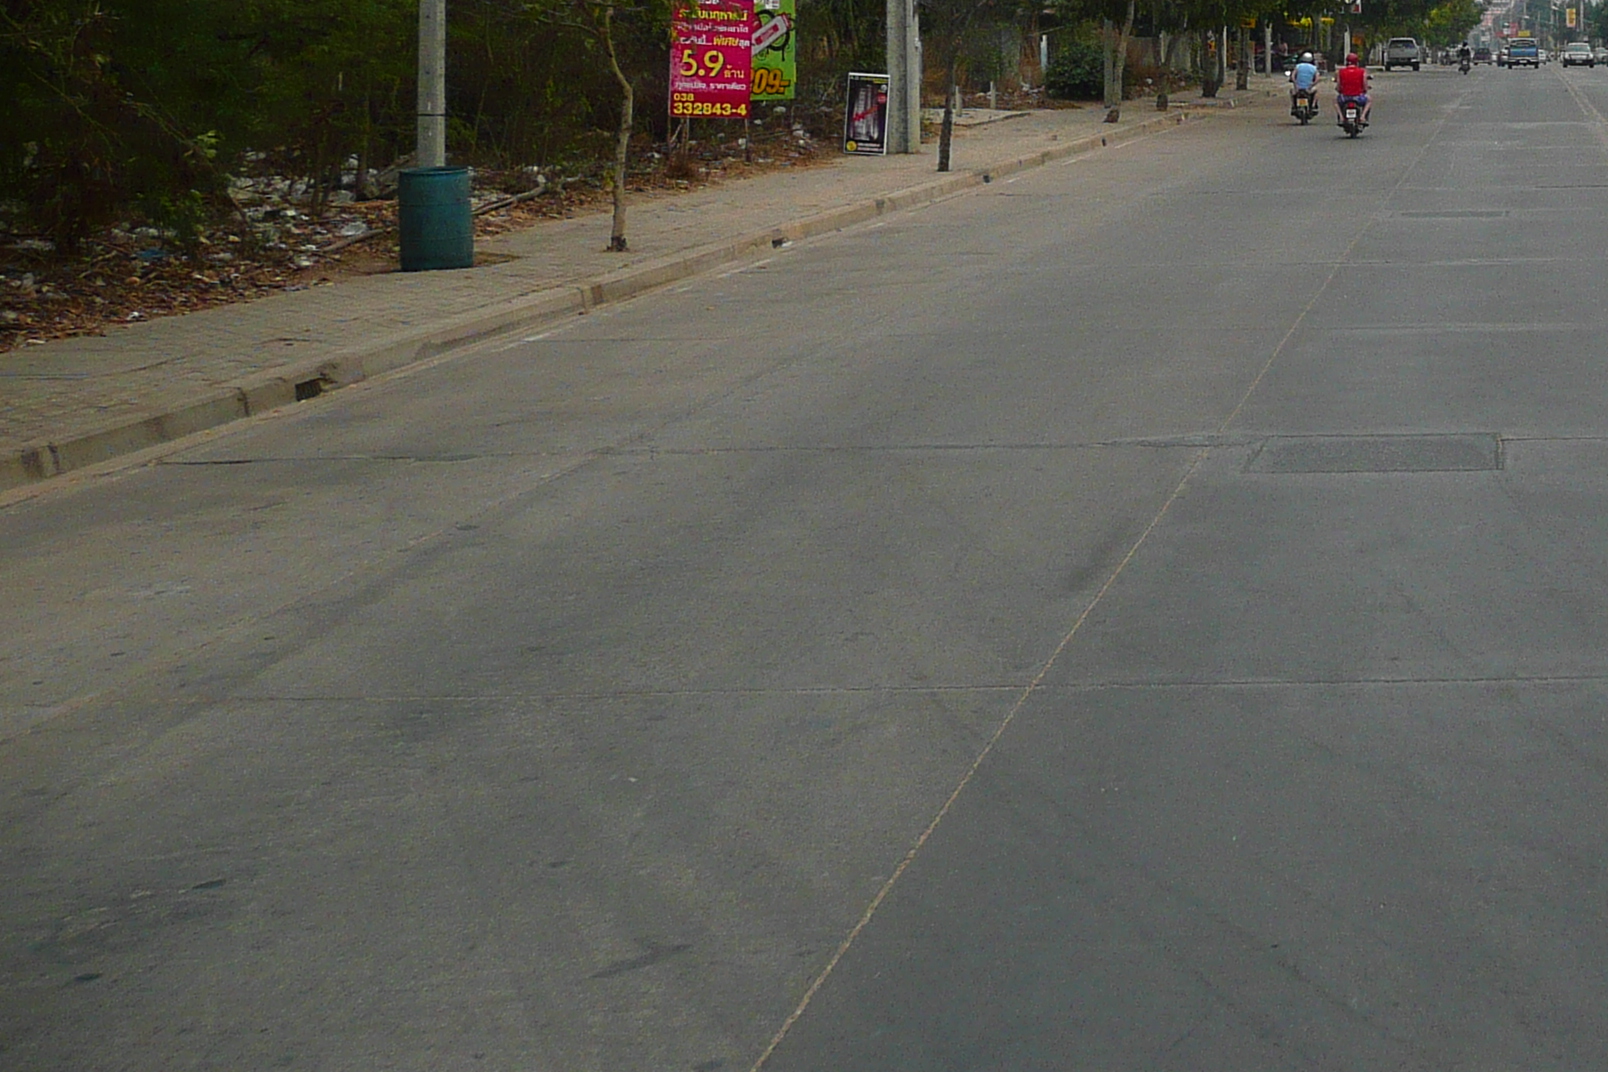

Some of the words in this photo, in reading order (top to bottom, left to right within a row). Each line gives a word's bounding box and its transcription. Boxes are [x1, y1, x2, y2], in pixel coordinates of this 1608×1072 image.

[679, 49, 725, 77] 5.9
[673, 93, 695, 101] 038
[673, 102, 748, 116] 332843-4
